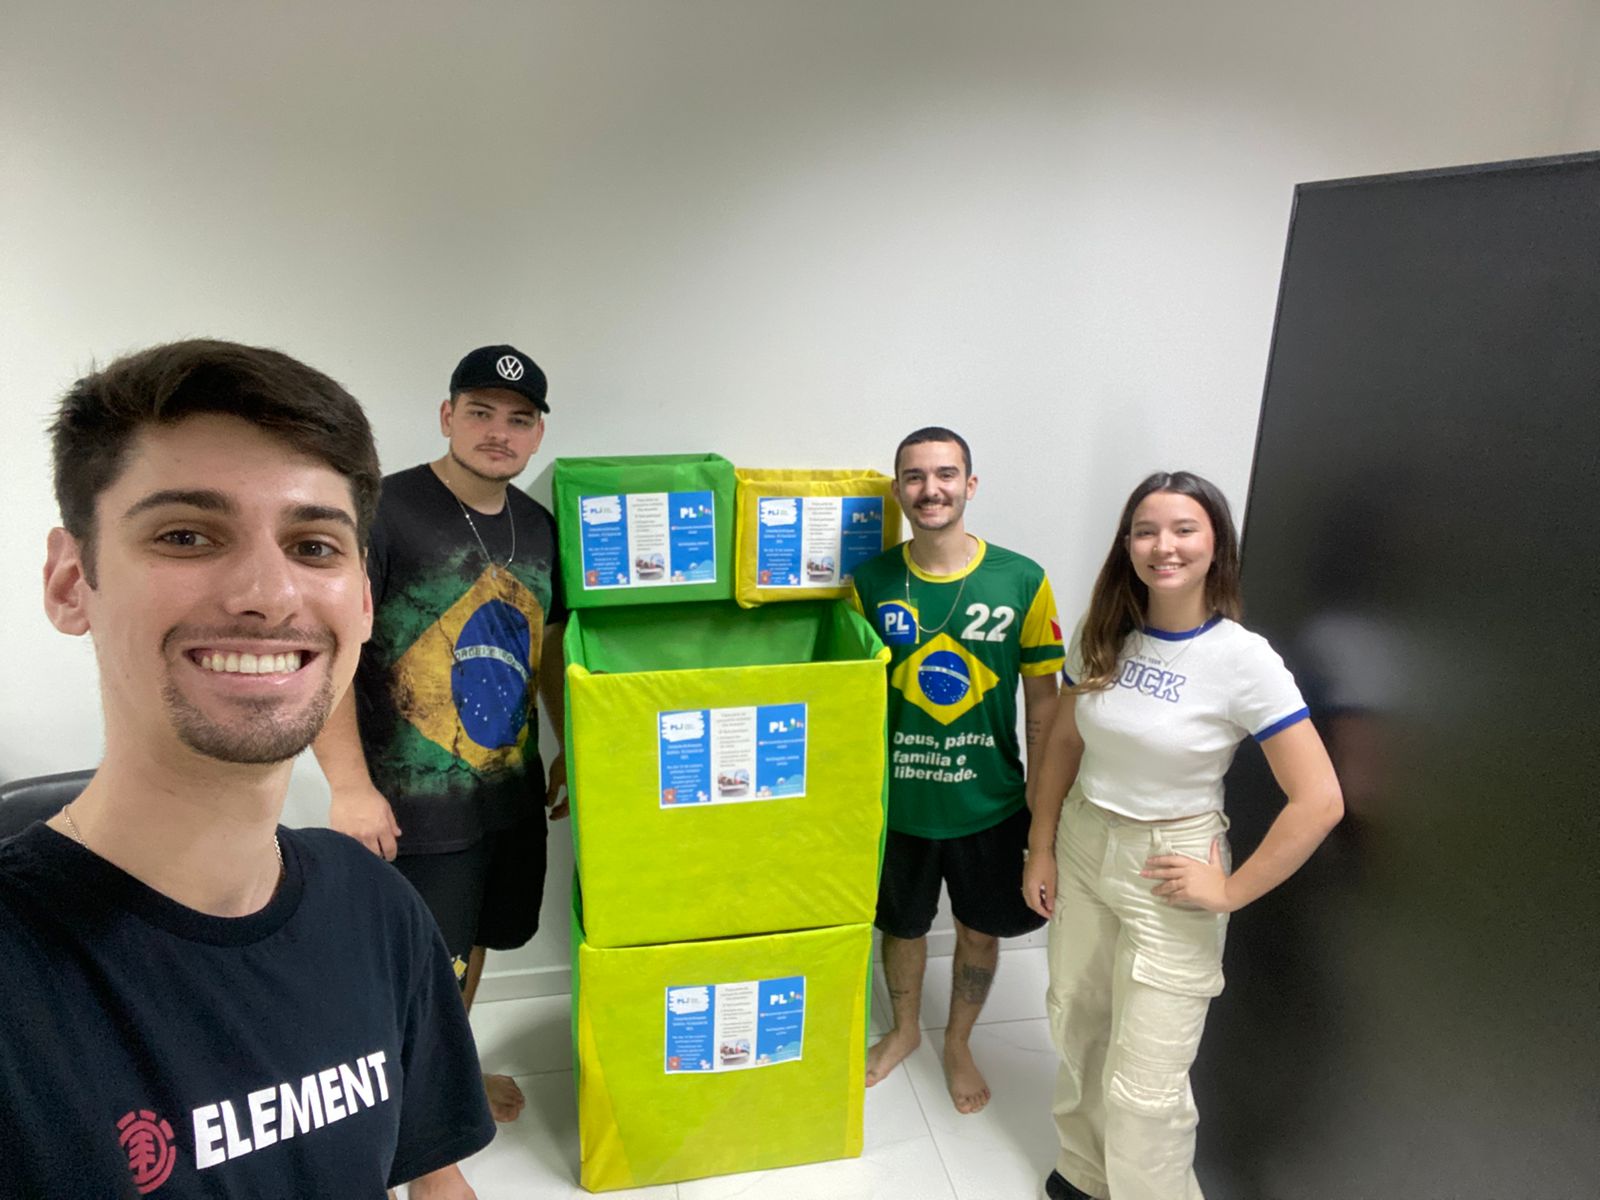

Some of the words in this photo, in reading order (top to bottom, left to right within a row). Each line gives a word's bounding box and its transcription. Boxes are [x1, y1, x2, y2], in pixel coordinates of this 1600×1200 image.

[884, 611, 910, 632] PL
[960, 603, 1015, 642] 22
[893, 731, 940, 749] Deus,
[893, 751, 952, 767] família
[956, 754, 967, 766] e
[894, 766, 978, 783] liberdade.
[192, 1050, 390, 1170] ELEMENT
